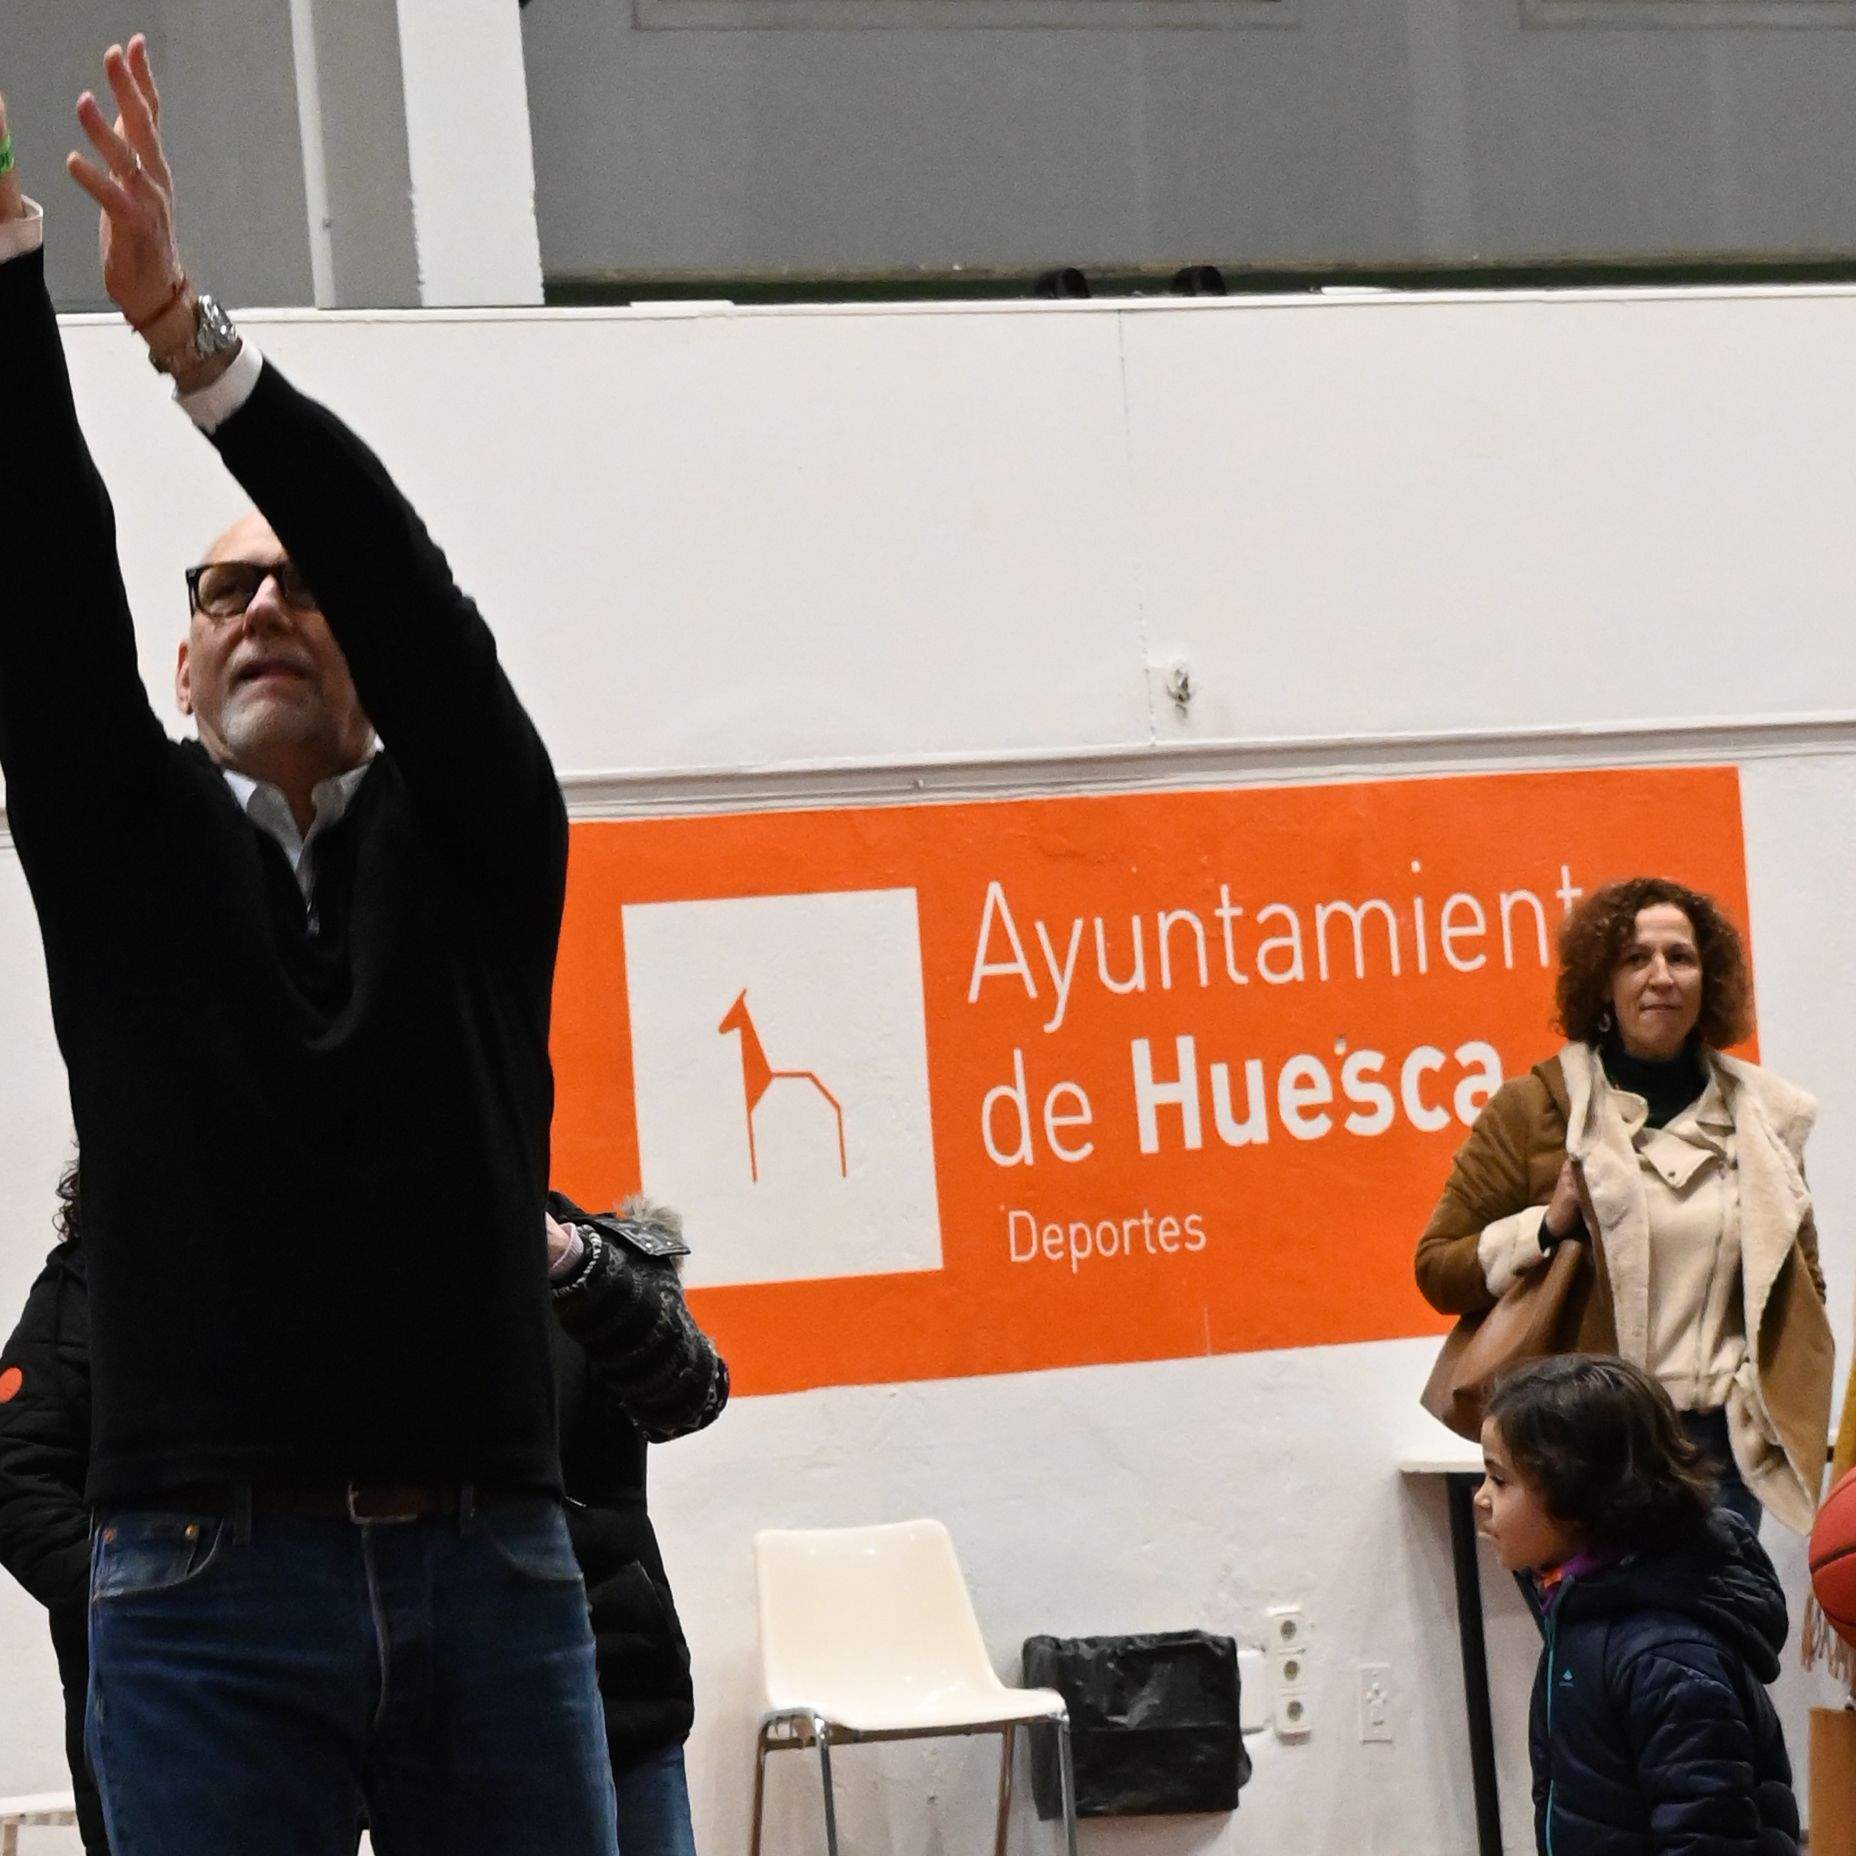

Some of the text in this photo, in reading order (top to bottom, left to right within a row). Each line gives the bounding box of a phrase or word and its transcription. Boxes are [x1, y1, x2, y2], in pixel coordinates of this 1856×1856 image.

[967, 860, 1584, 1034] Ayuntamient
[981, 1034, 1504, 1167] de Huesca
[1007, 1209, 1207, 1274] Deportes
